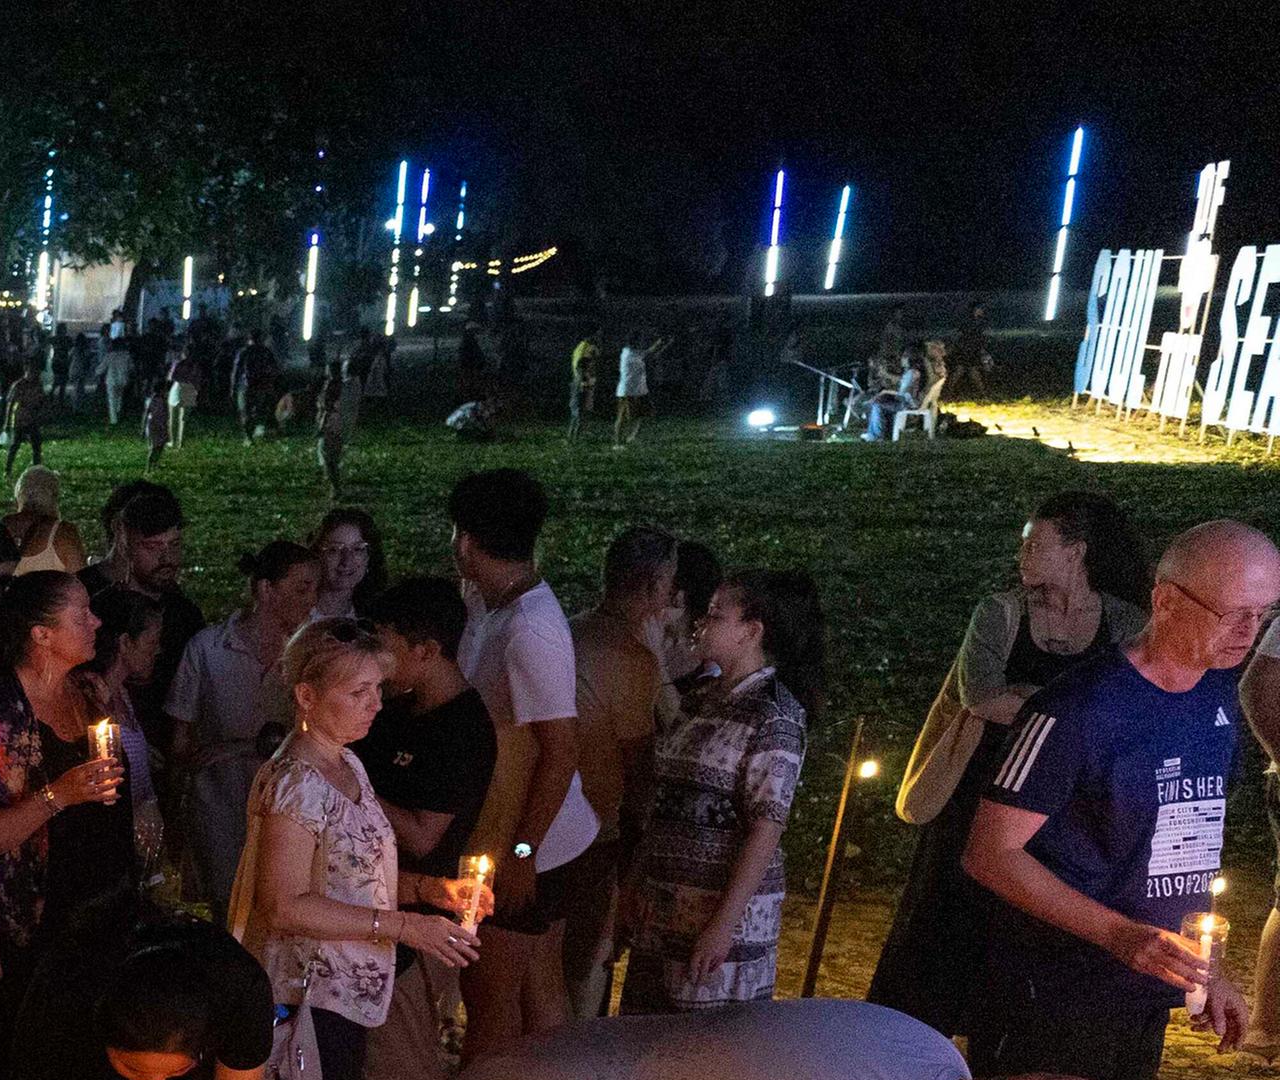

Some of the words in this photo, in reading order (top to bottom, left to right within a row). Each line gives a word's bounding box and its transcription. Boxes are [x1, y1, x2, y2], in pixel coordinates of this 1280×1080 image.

[1194, 160, 1230, 241] OF
[1074, 249, 1164, 410] SOUL
[1157, 775, 1224, 803] FINISHER
